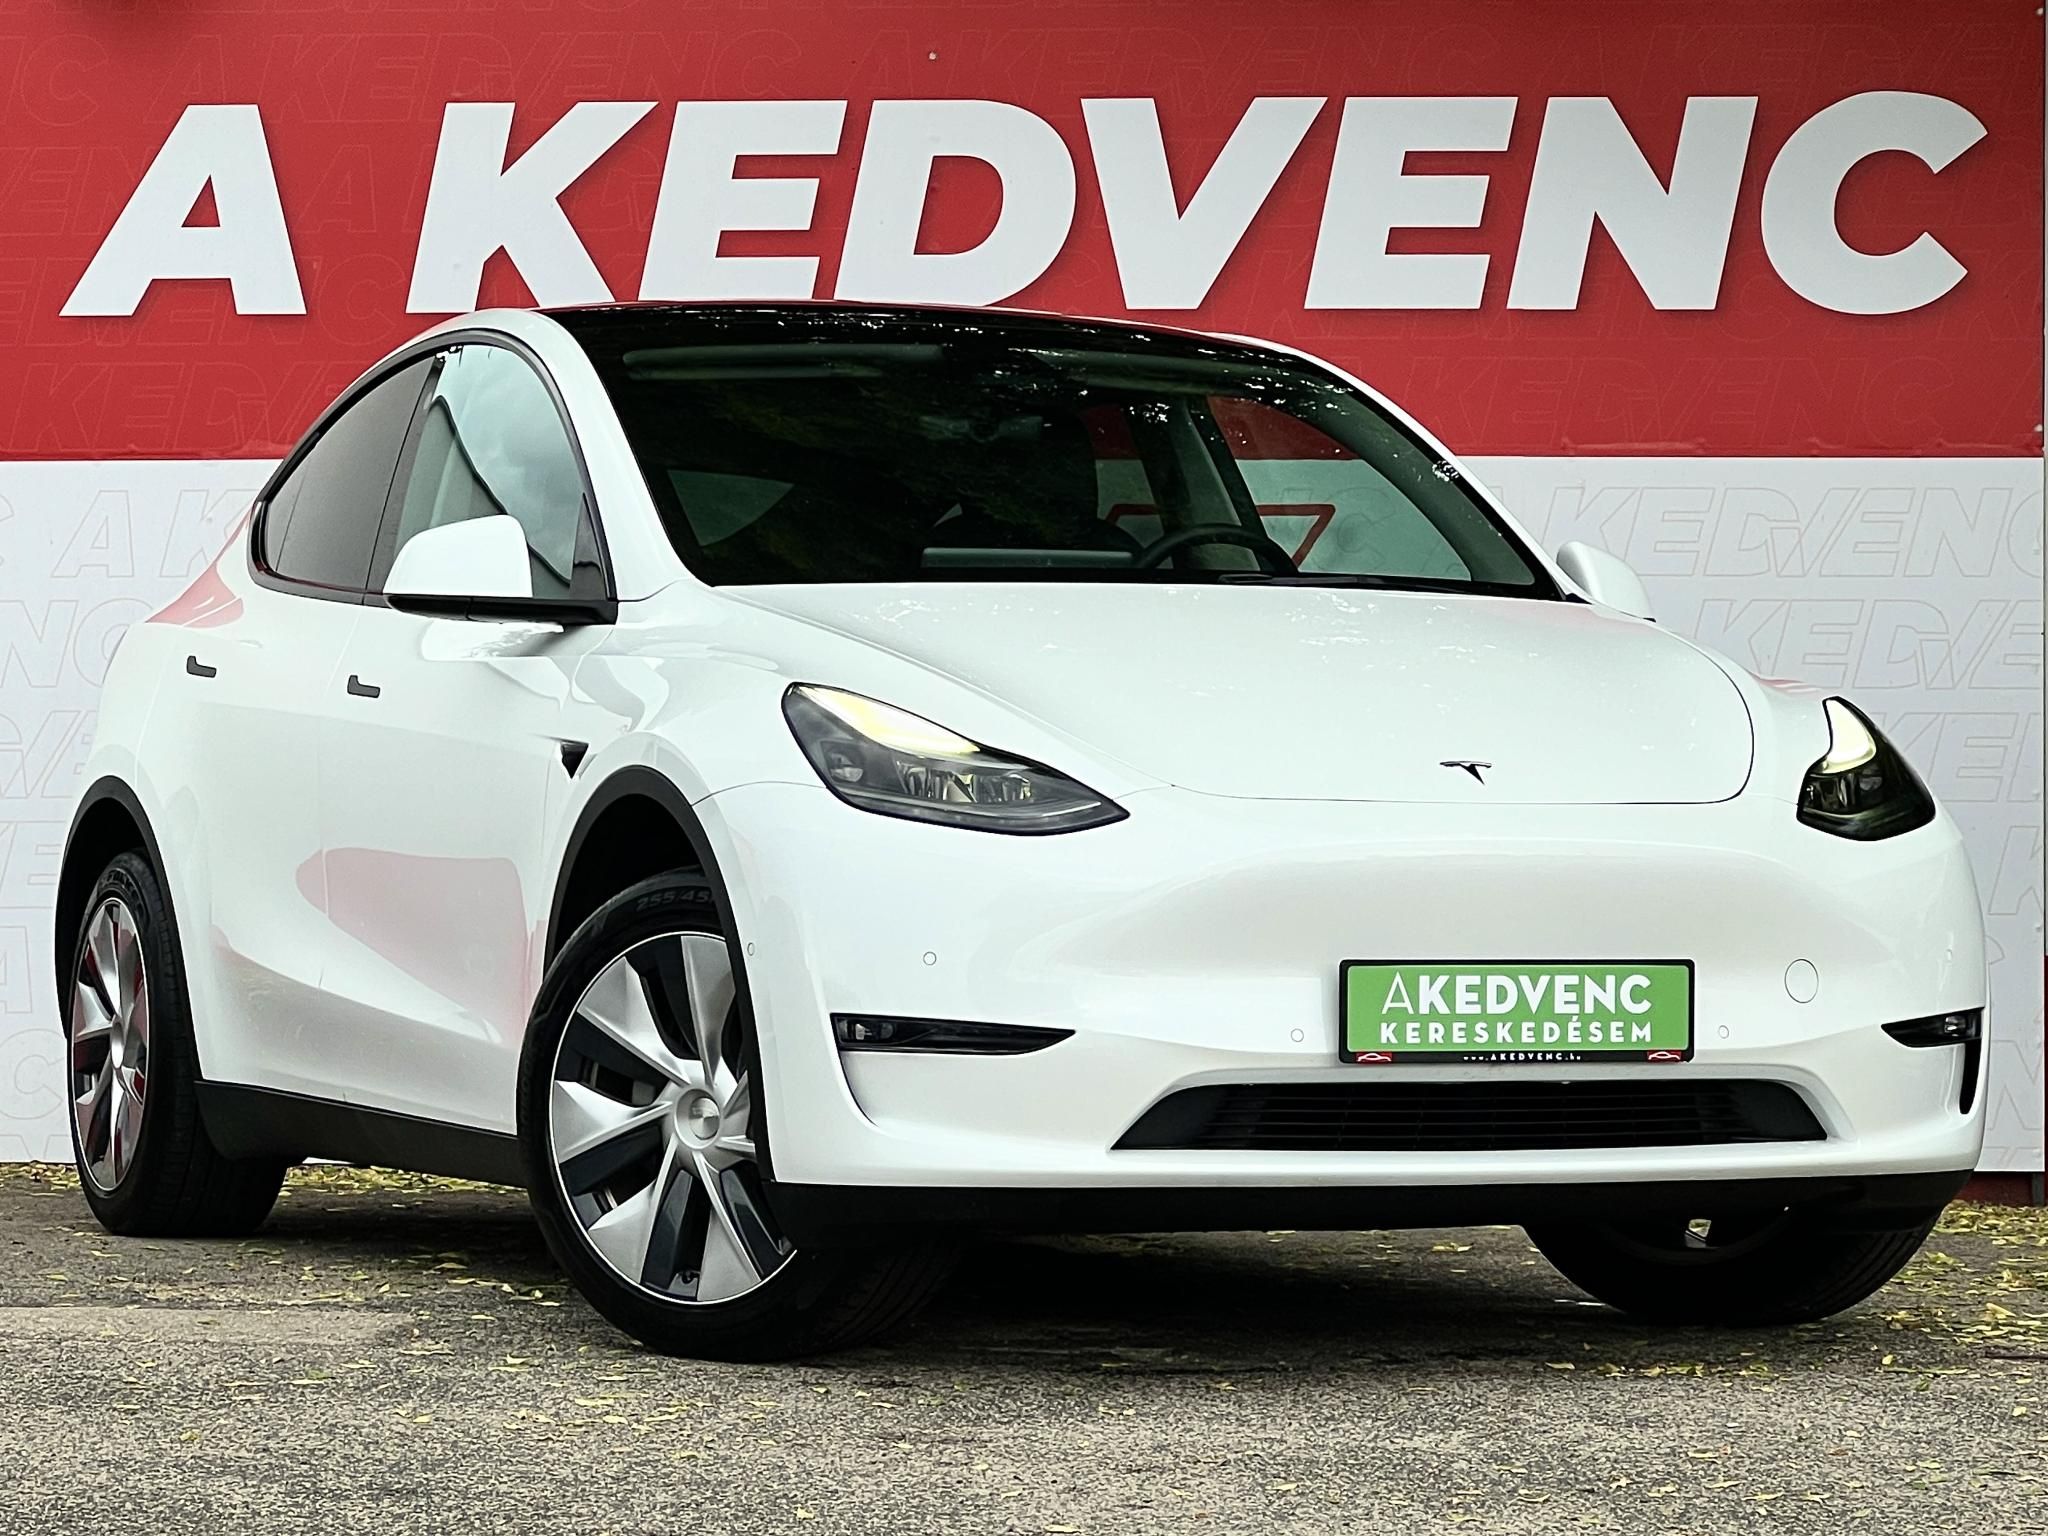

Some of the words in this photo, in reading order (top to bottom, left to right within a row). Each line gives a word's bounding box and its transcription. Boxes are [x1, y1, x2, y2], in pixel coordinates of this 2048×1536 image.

[59, 103, 307, 316] A
[405, 90, 1989, 315] KEDVENC
[1381, 971, 1653, 1015] AKEDVENC
[1380, 1015, 1652, 1044] KERESKEDÉSEM
